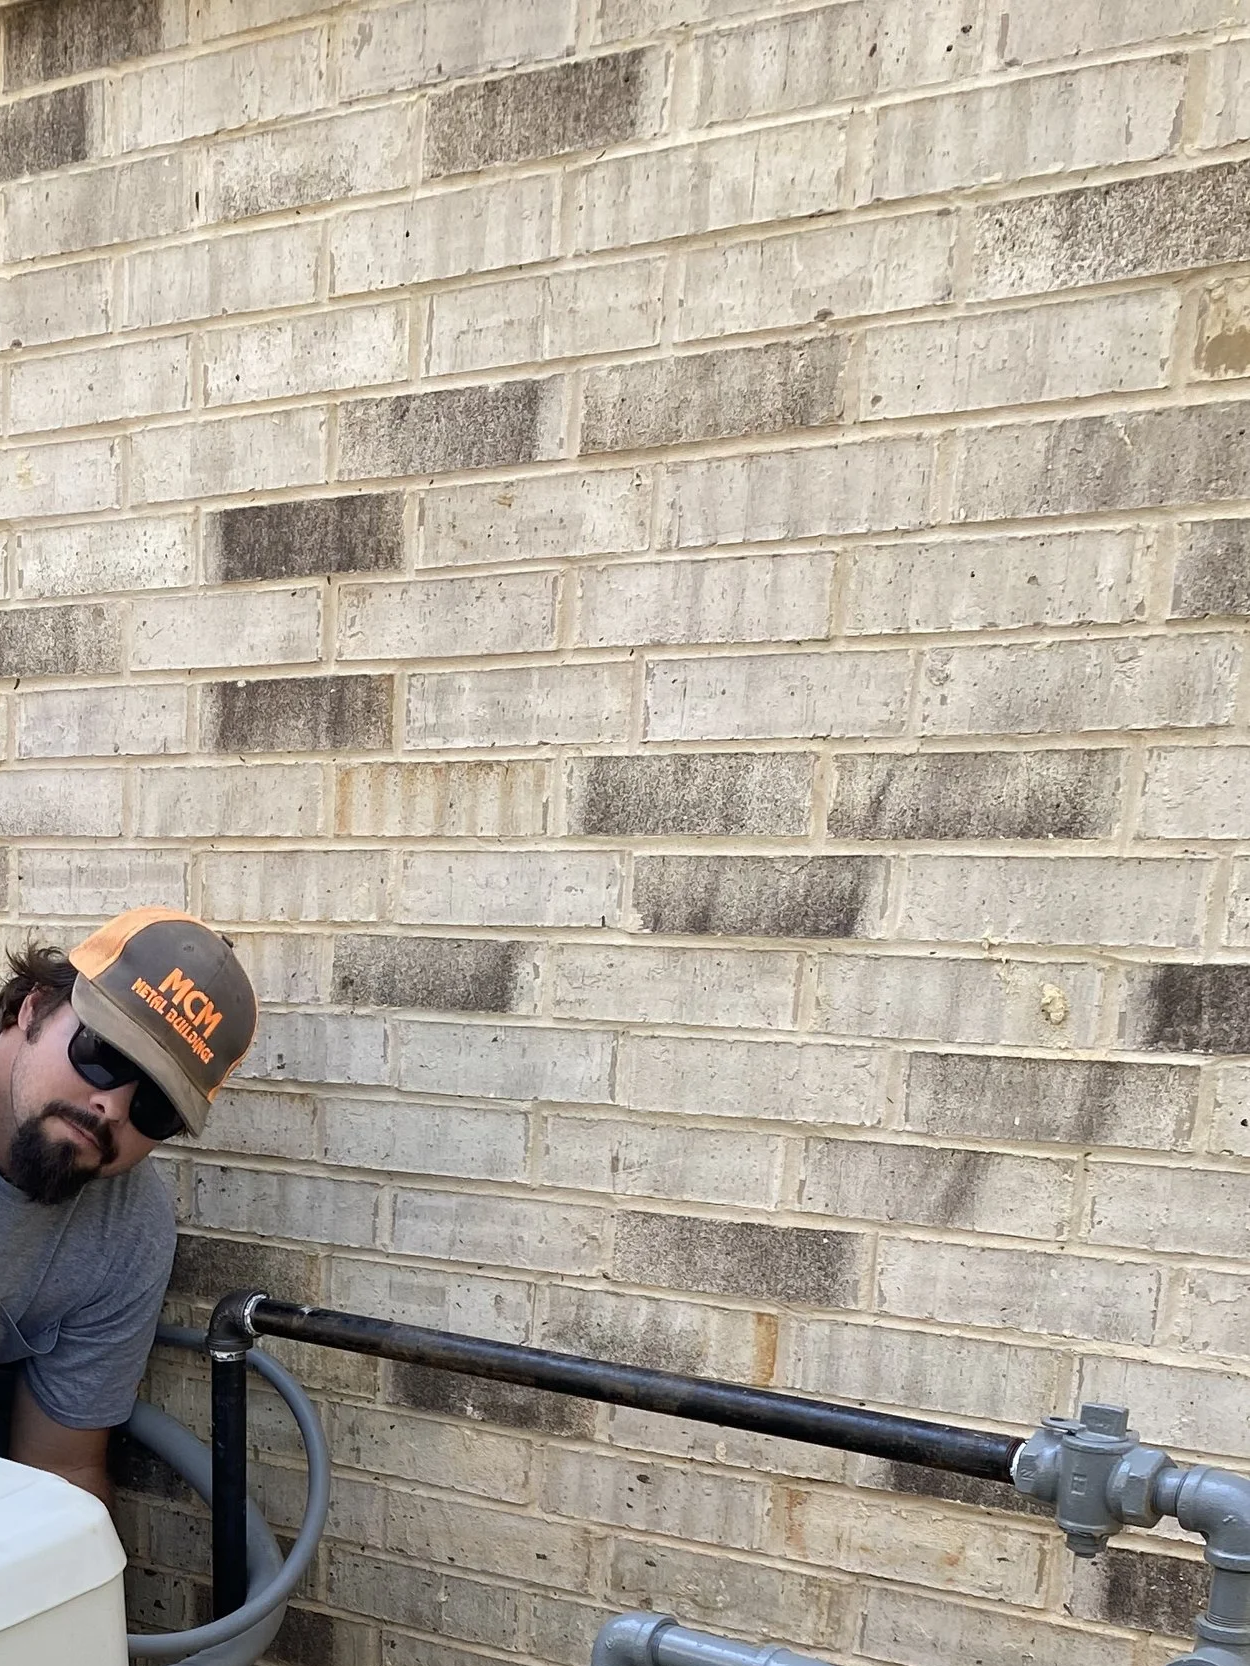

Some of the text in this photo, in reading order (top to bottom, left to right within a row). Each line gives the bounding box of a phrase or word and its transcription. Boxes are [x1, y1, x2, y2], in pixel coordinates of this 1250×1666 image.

[131, 977, 215, 1064] METAL BUILDINGS
[158, 968, 222, 1039] MCM
